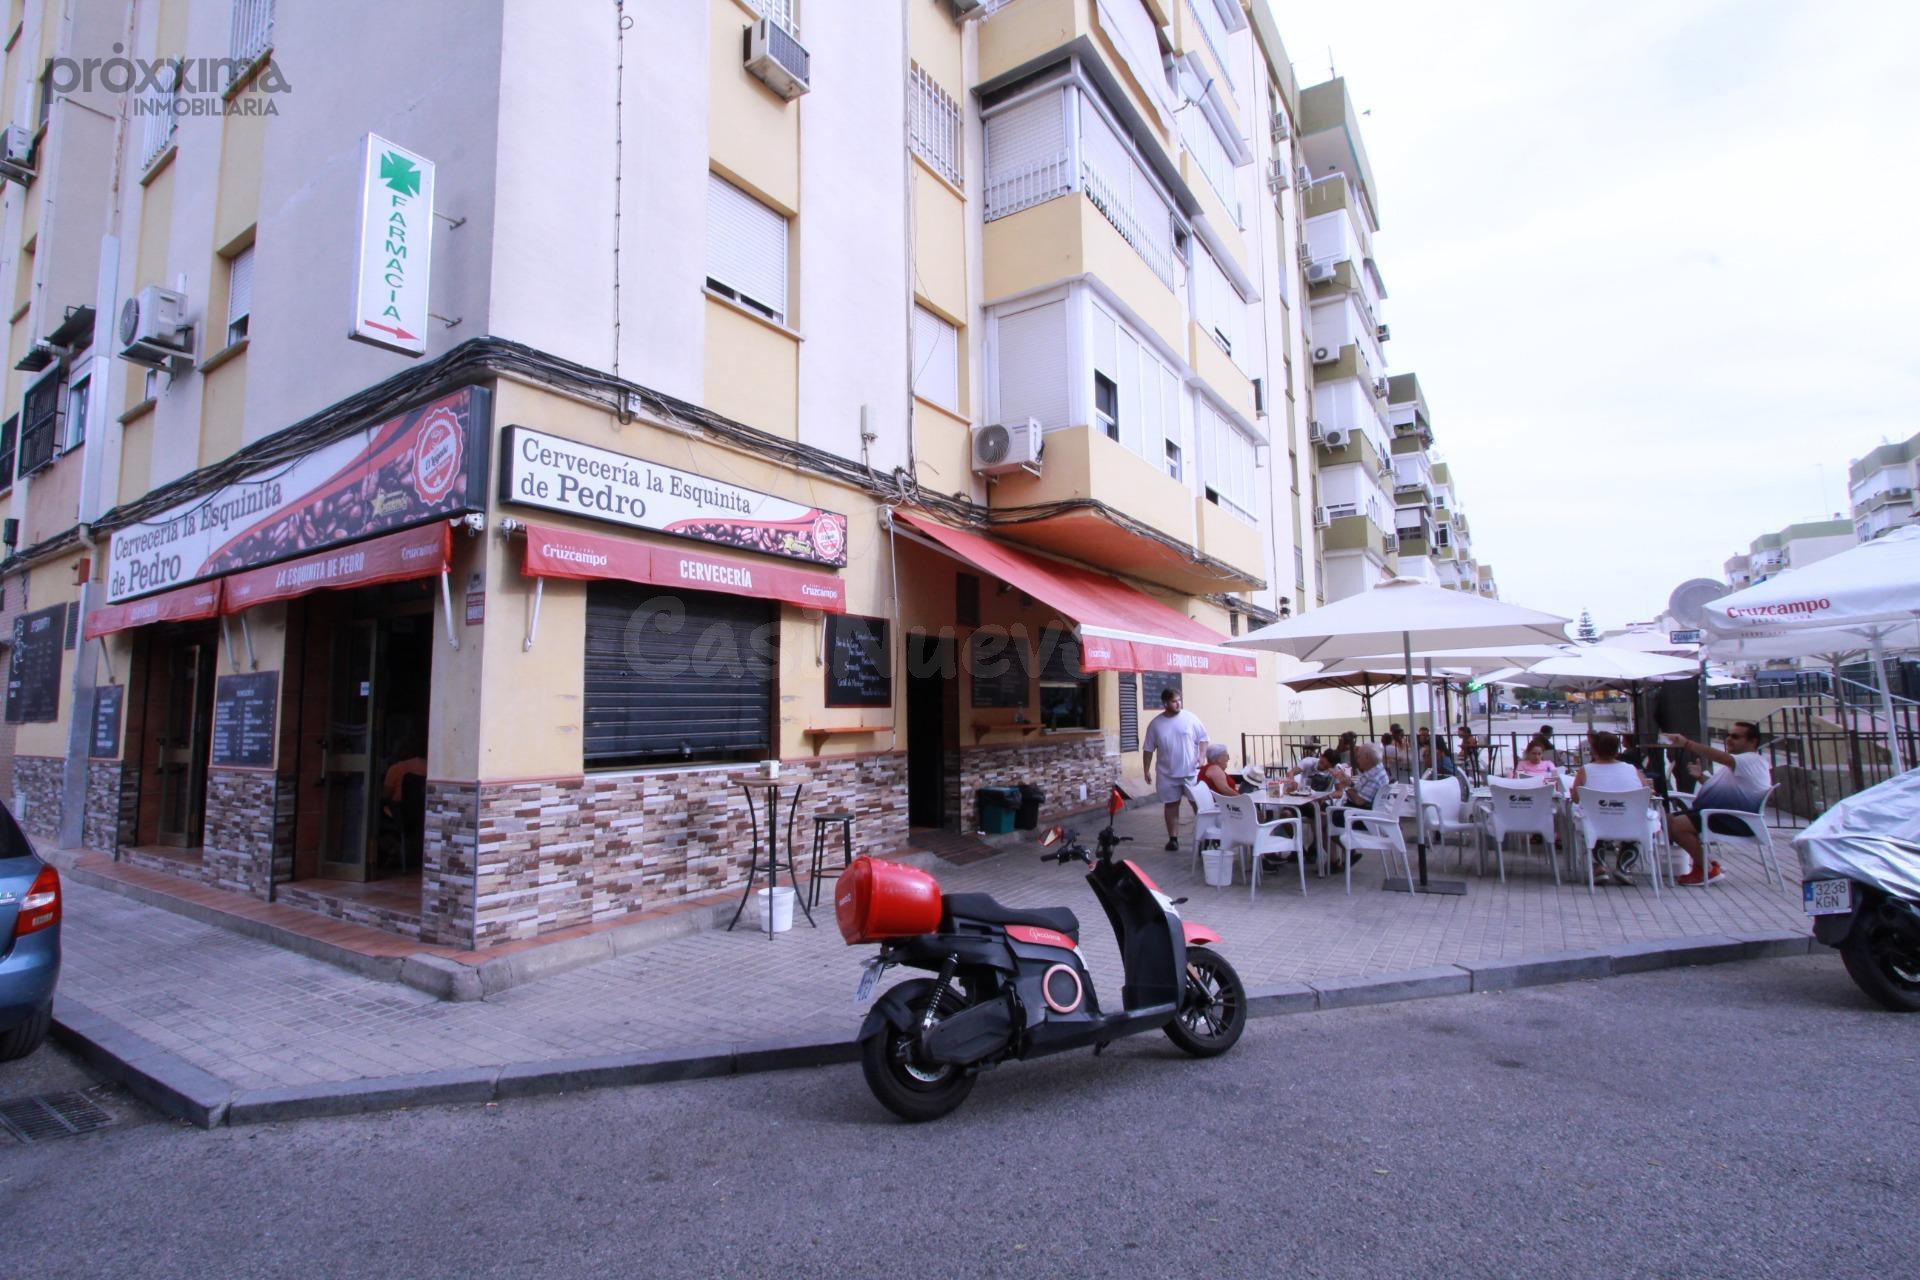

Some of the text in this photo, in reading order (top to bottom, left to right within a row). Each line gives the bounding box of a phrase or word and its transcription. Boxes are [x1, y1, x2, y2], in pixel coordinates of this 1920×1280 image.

[383, 194, 407, 321] FARMACIA
[522, 437, 751, 514] Cervecería la Esquinita
[521, 472, 646, 518] de Pedro
[115, 482, 282, 560] Cervecería la Esquinita
[276, 552, 365, 588] LA ESQUINITA DE PEDRO
[543, 544, 608, 566] Cruzcampo
[112, 552, 181, 596] de Pedro
[680, 559, 752, 588] CERVECERÍA
[802, 584, 838, 600] Cruzcampo
[1727, 598, 1831, 619] Cruzcampo
[1816, 896, 1839, 908] KGN
